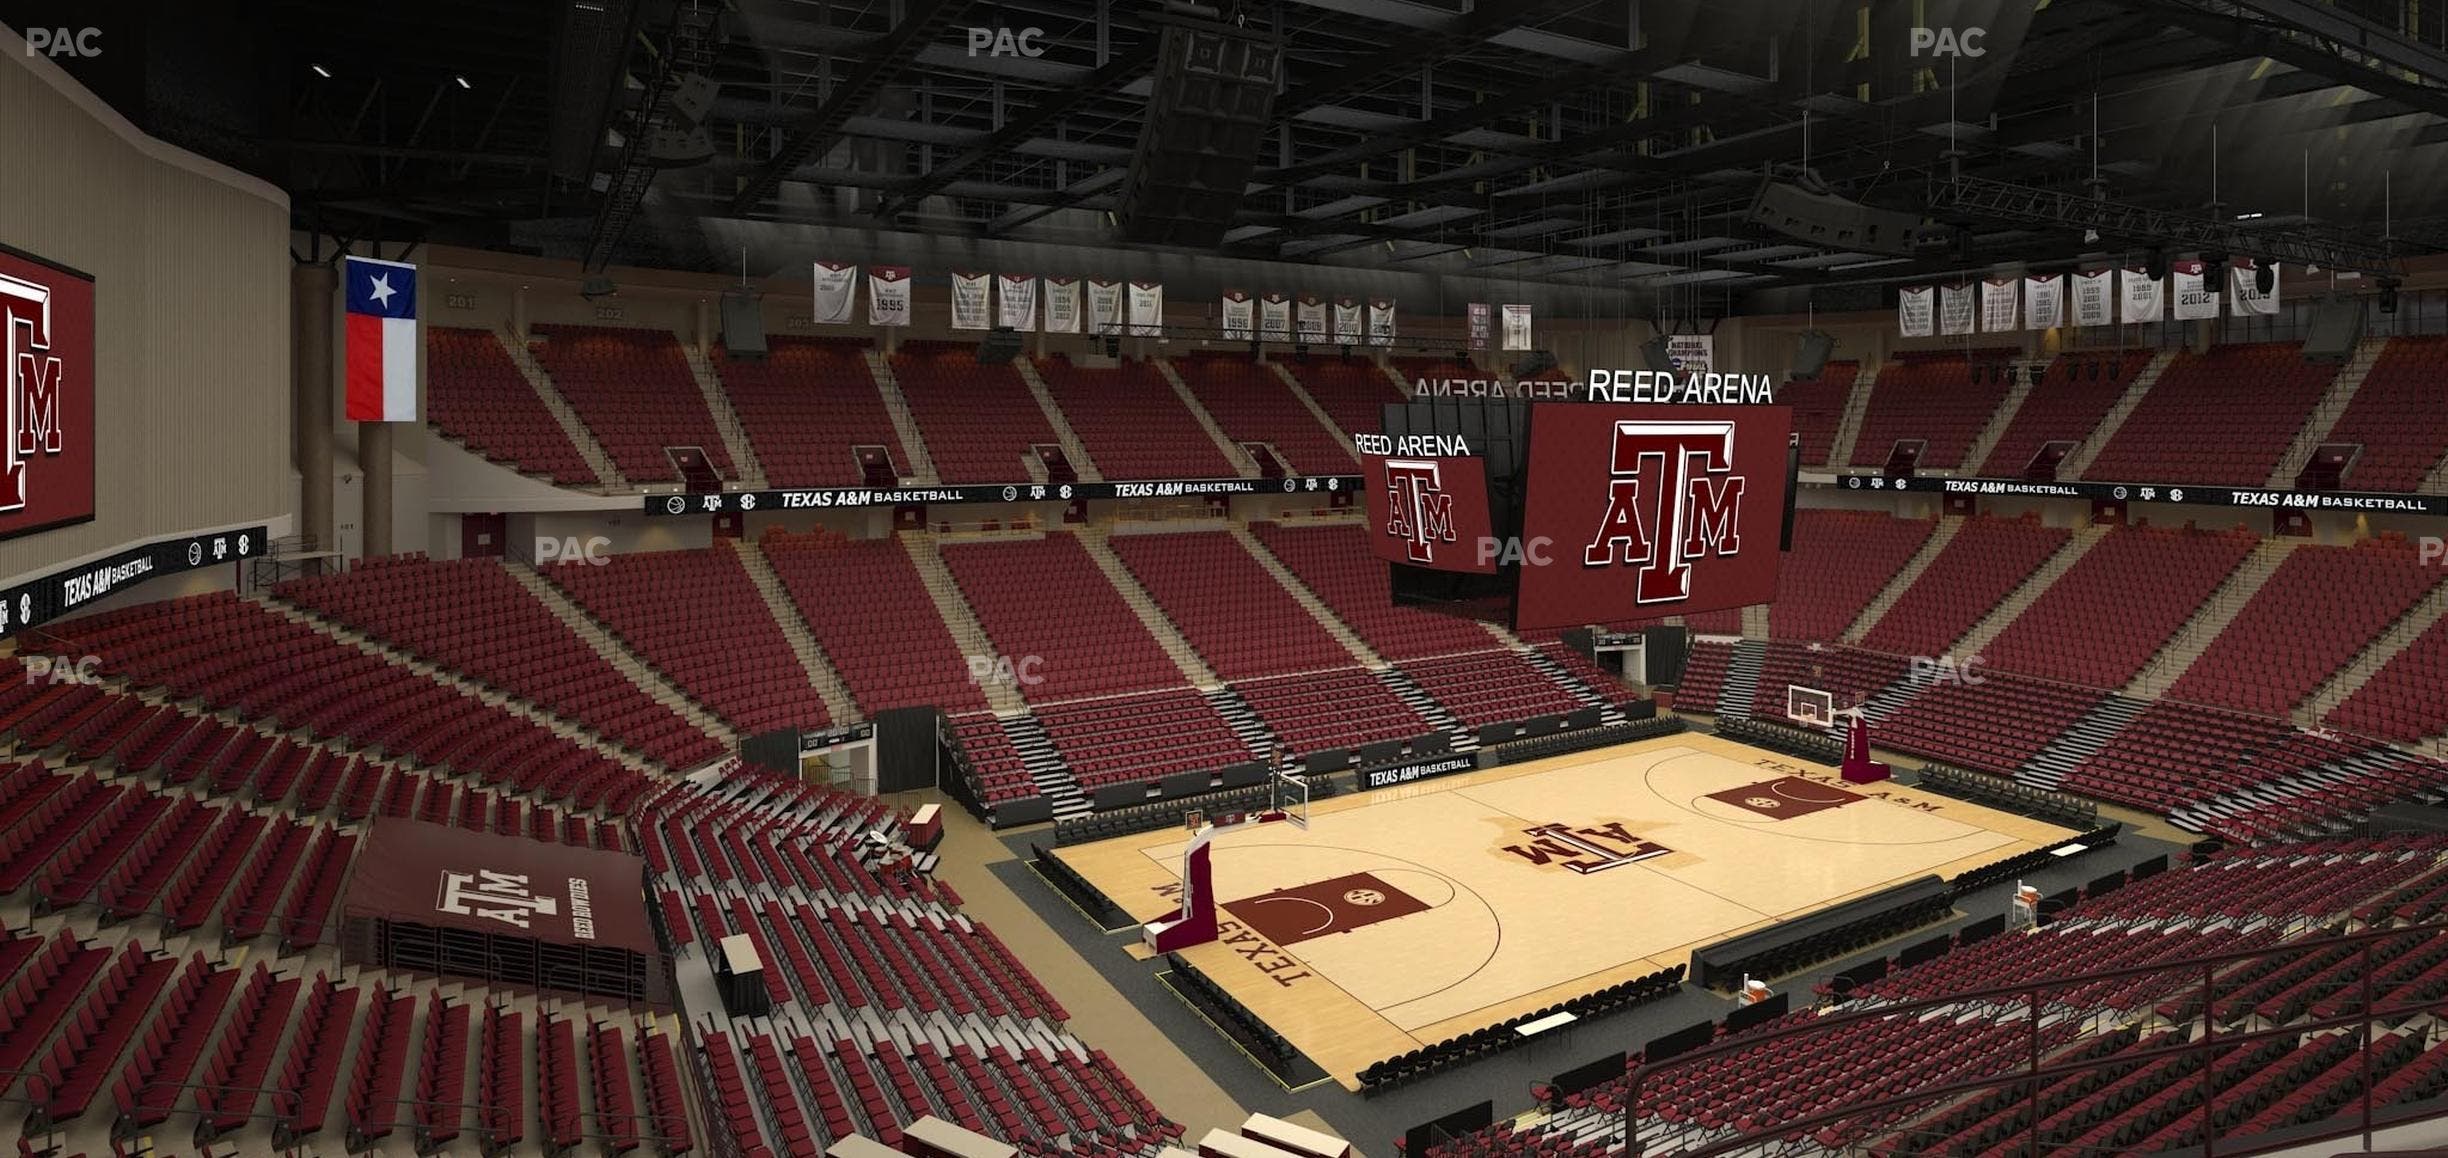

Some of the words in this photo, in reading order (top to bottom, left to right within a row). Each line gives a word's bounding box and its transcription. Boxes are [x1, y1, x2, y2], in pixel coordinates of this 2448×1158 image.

[877, 299, 904, 312] 1995
[2181, 293, 2210, 305] 2012
[1264, 319, 1286, 329] 2007
[1588, 369, 1674, 402] REED
[1682, 372, 1773, 404] ARENA
[1355, 433, 1392, 456] REED
[1397, 434, 1471, 456] ARENA
[782, 491, 832, 508] TEXAS
[835, 490, 871, 506] A&M
[874, 489, 963, 503] BASKETBALL
[1115, 484, 1153, 497] TEXAS
[1155, 483, 1183, 495] A&M
[1185, 481, 1254, 493] BASKETBALL
[1945, 480, 1978, 492] TEXAS
[1980, 482, 2005, 493] A&M
[2007, 484, 2078, 495] BASKETBALL
[2231, 491, 2279, 506] TEXAS
[2282, 493, 2319, 507] A&M
[2322, 496, 2427, 511] BASKETBALL
[64, 574, 92, 607] TEXAS
[92, 566, 111, 596] A&M
[112, 555, 153, 584] BASKETBALL
[1370, 769, 1398, 786] TEXAS
[1399, 765, 1419, 781] A&M
[1420, 758, 1471, 775] BASKETBALL
[1754, 758, 1856, 789] TEXAS
[568, 877, 592, 918] ROWDIES
[572, 917, 595, 939] REED
[1218, 921, 1311, 987] TEXAS
